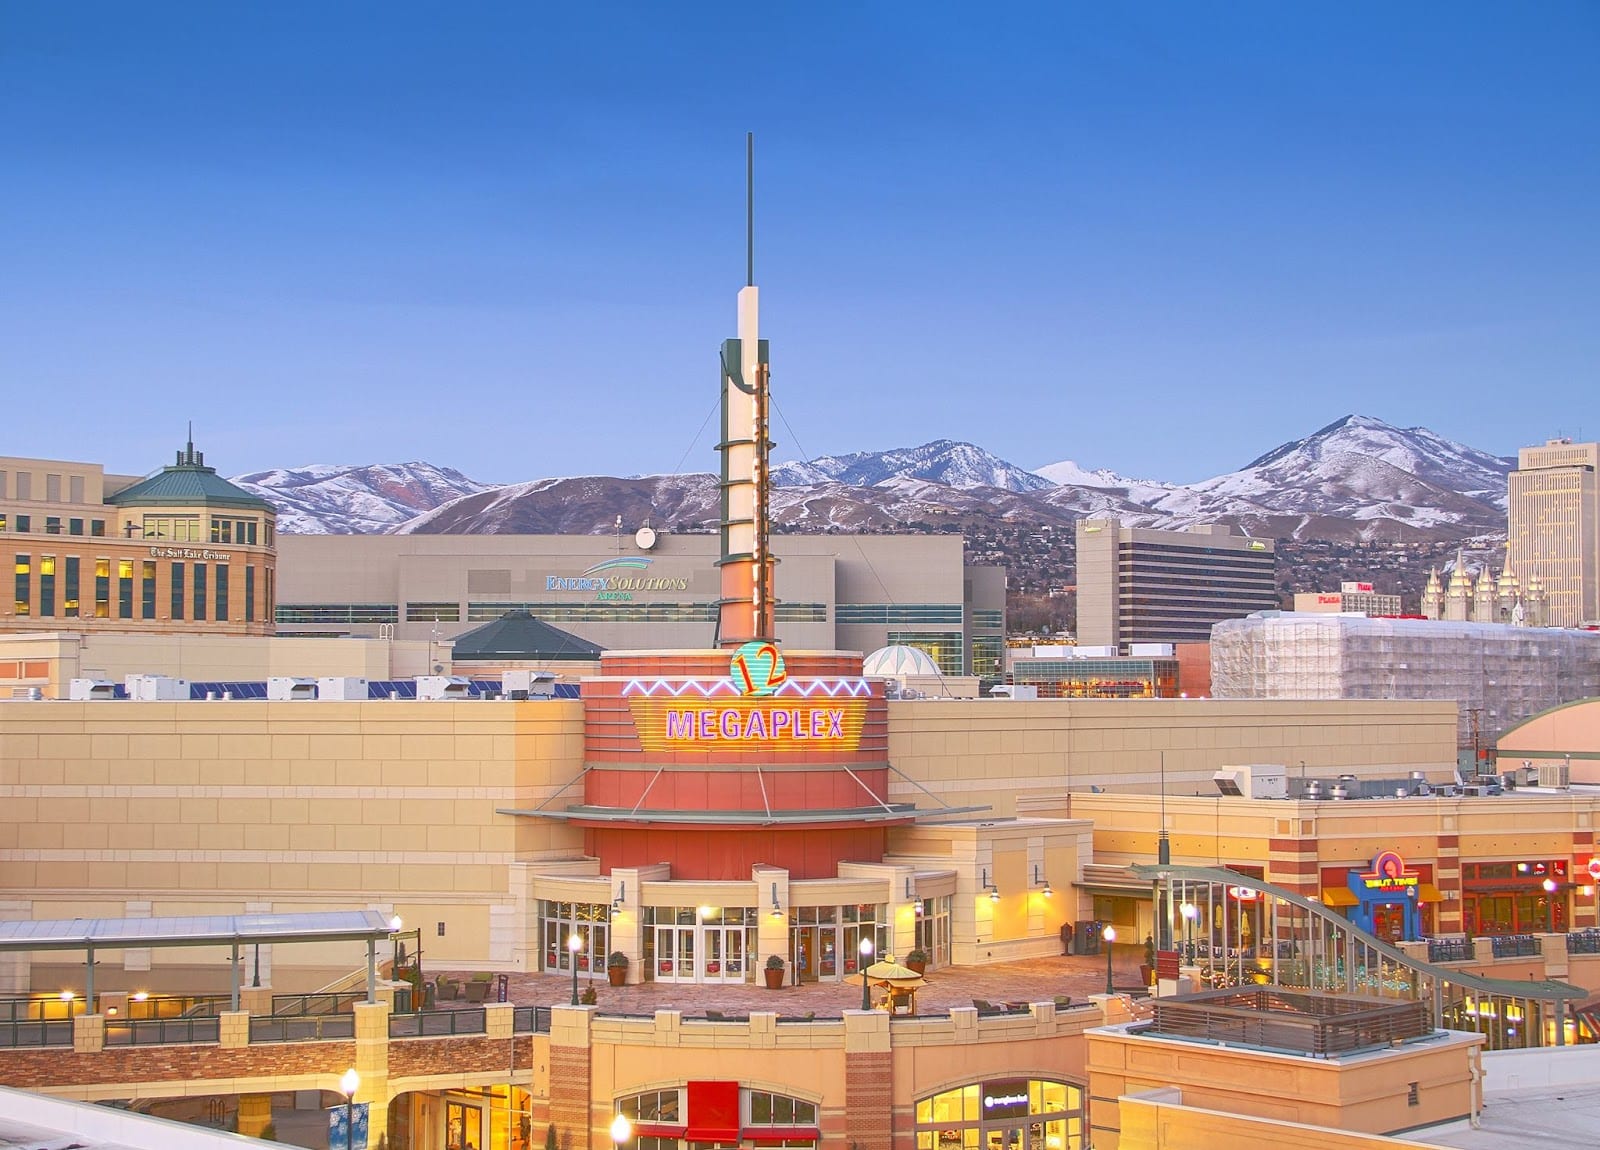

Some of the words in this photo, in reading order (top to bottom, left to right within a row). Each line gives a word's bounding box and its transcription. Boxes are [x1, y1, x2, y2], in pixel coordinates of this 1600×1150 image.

[150, 547, 164, 557] The
[165, 548, 182, 559] Salt
[183, 549, 201, 559] Lake
[203, 550, 231, 560] Tribune
[733, 644, 787, 695] 12
[666, 709, 844, 740] MEGAPLEX
